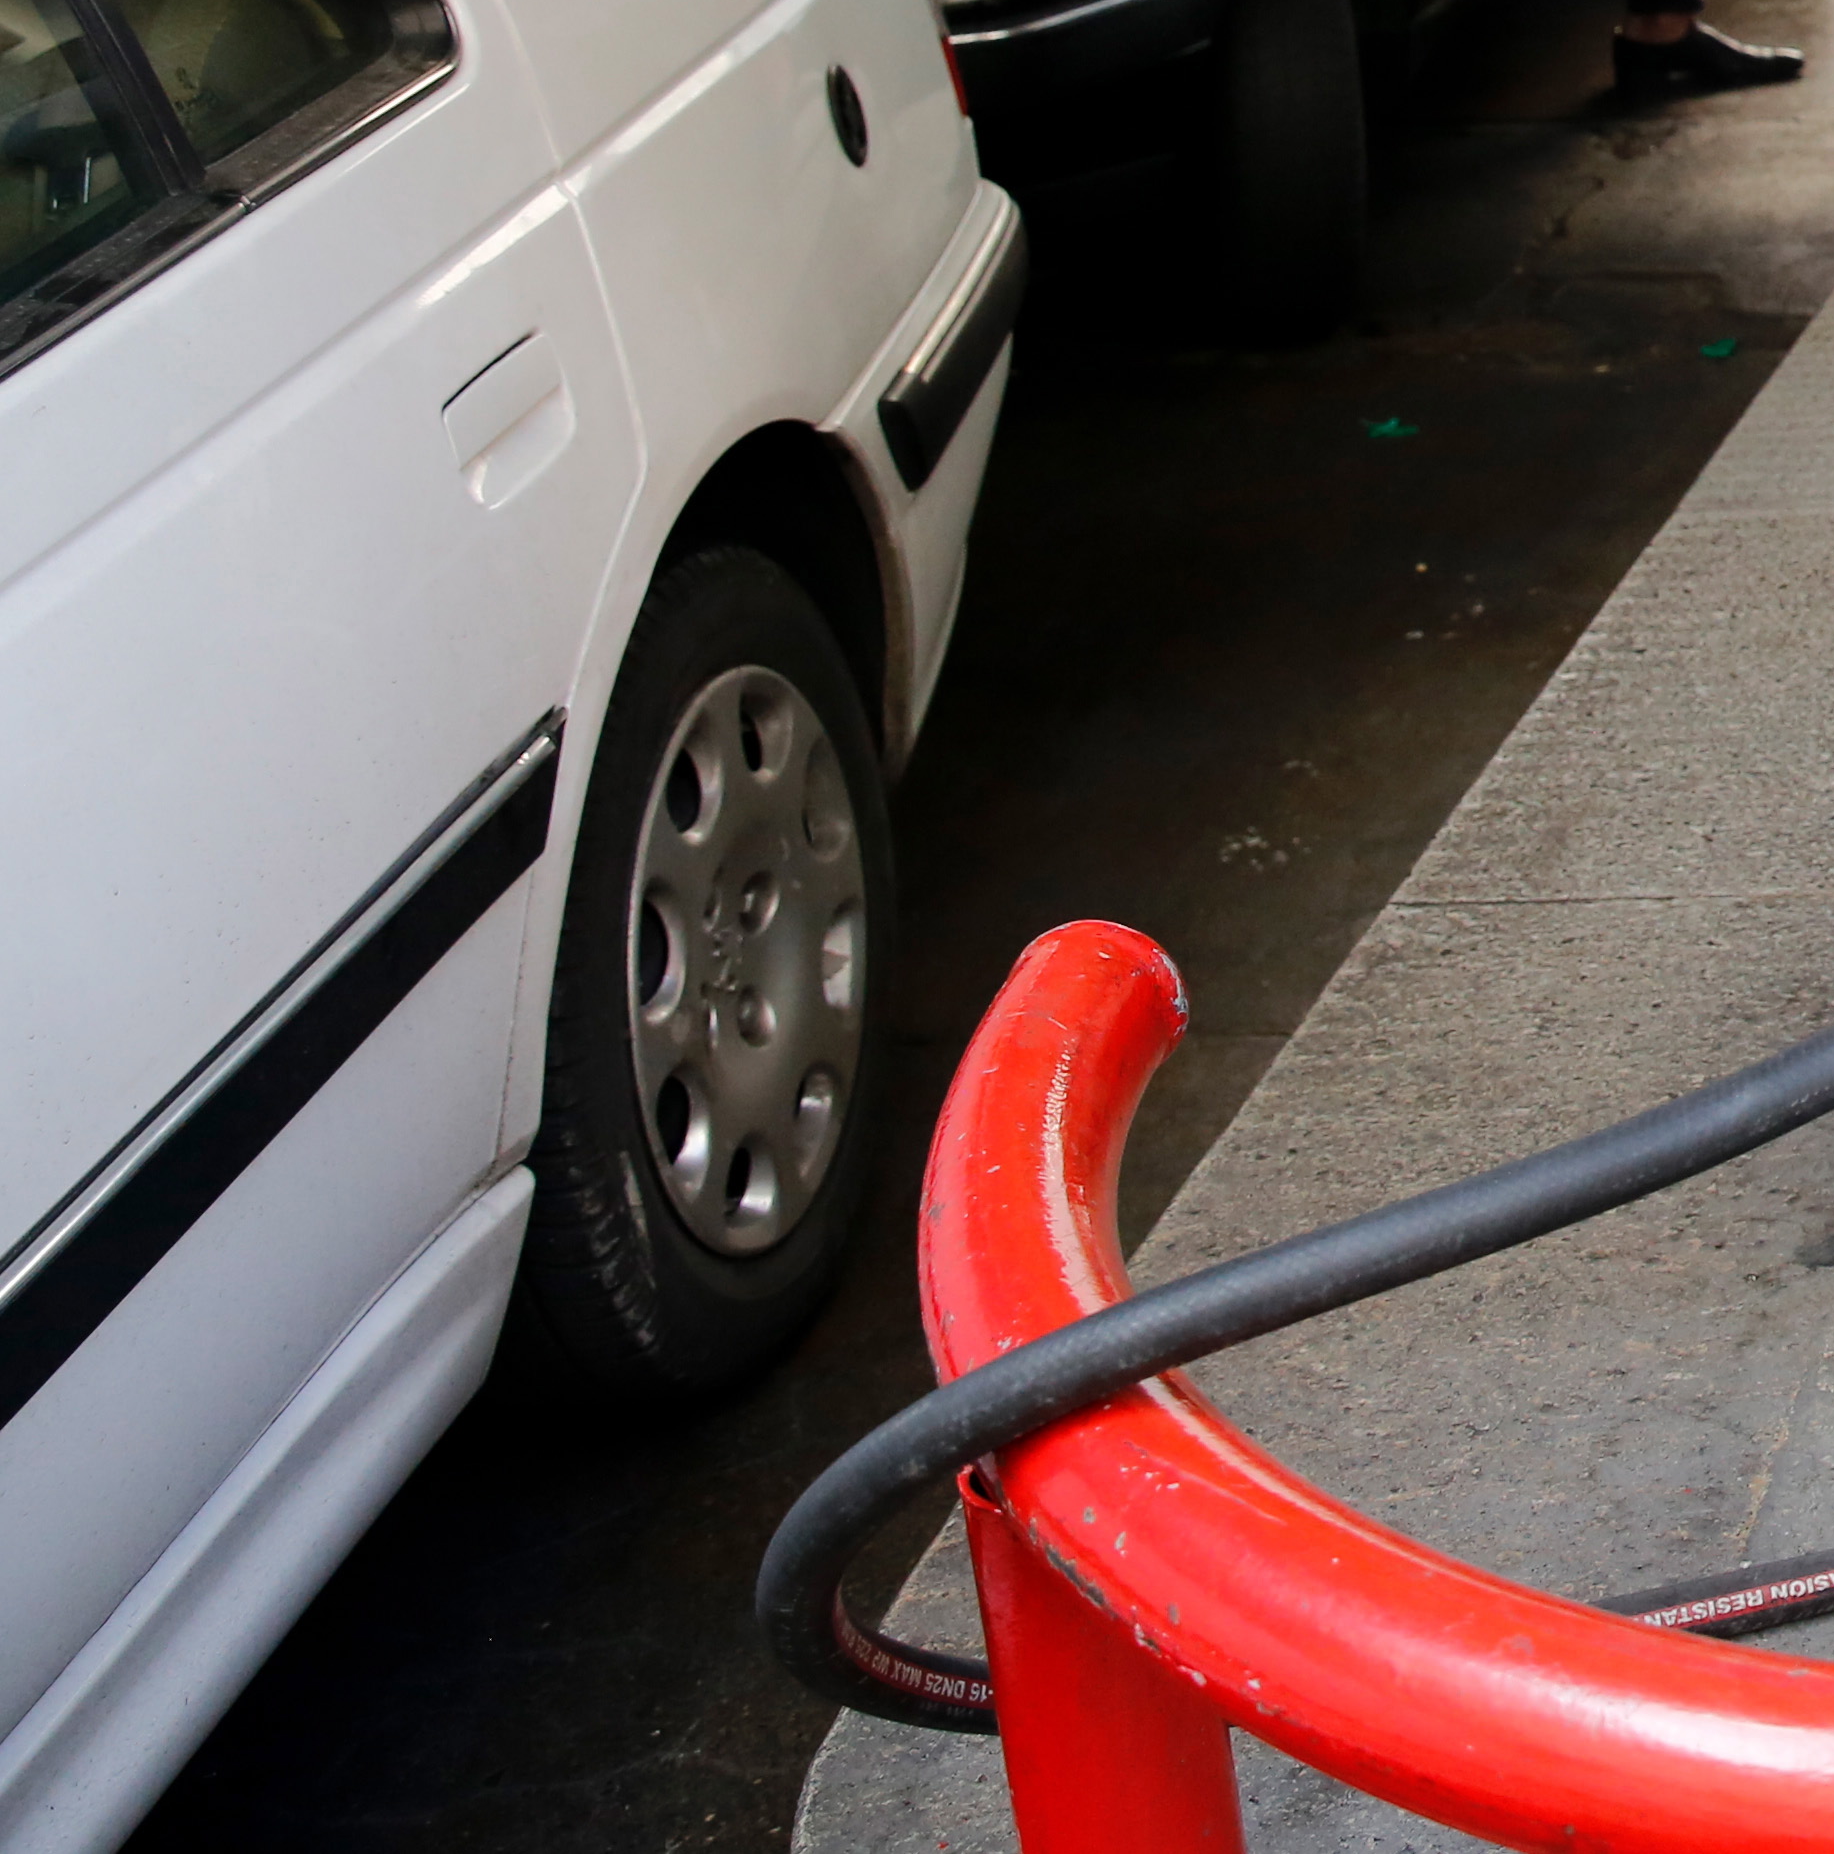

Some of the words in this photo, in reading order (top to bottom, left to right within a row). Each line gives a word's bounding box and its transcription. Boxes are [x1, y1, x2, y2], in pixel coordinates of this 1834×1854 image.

[1644, 1583, 1765, 1630] RESISTAN
[871, 1651, 890, 1675] WP
[889, 1658, 923, 1688] MAX
[924, 1672, 966, 1699] DN25
